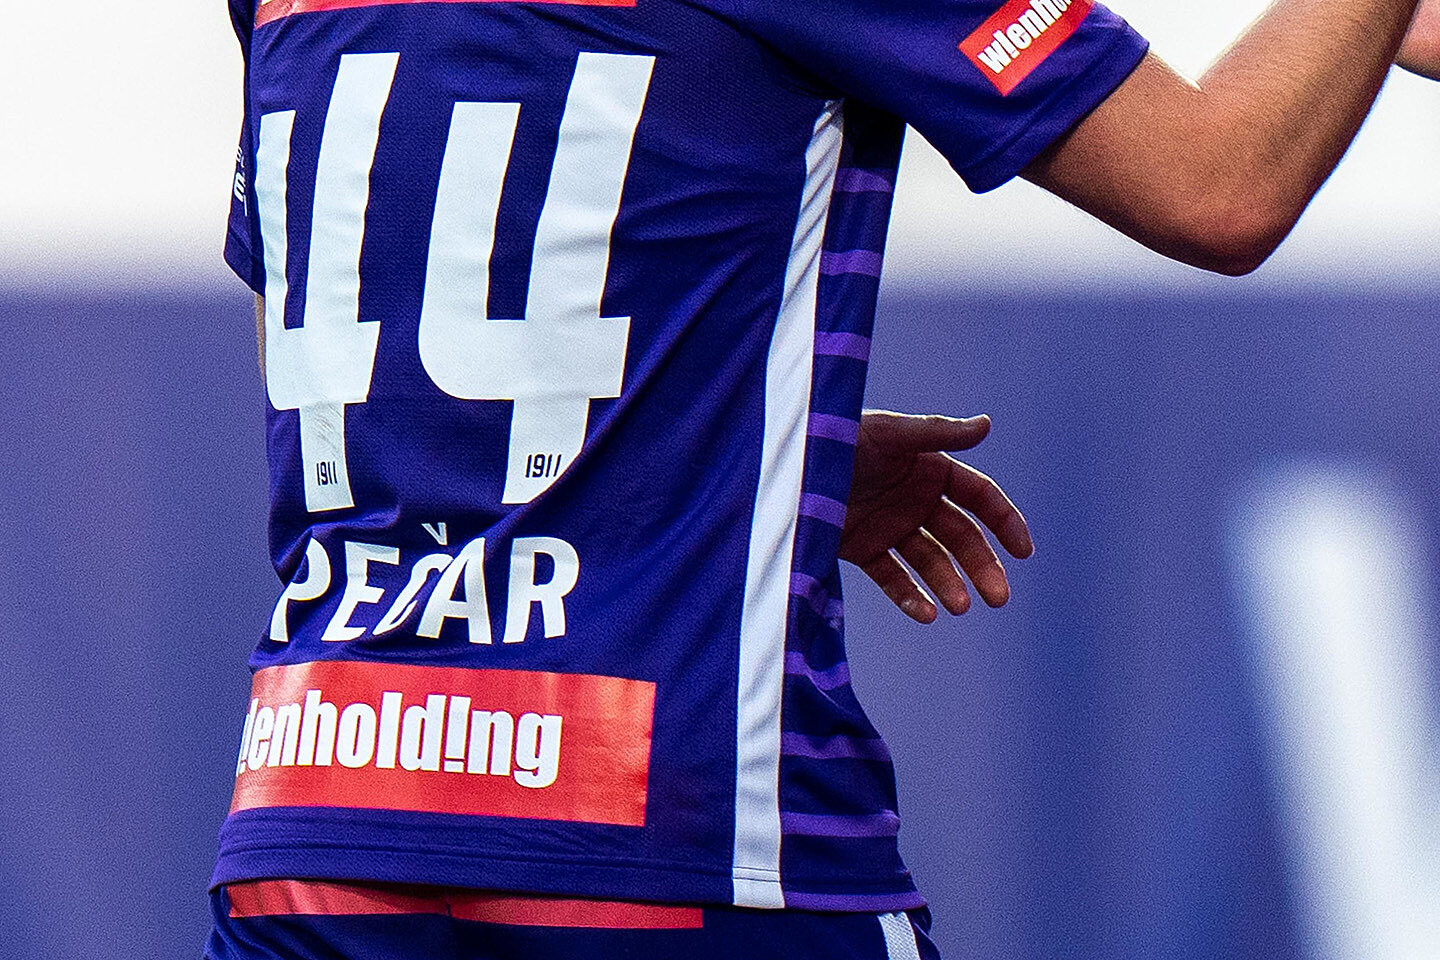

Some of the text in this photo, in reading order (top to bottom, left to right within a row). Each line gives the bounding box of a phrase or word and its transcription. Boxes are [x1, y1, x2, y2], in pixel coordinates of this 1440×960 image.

[255, 52, 656, 512] 44
[316, 460, 338, 486] 1911
[525, 454, 561, 477] 1911
